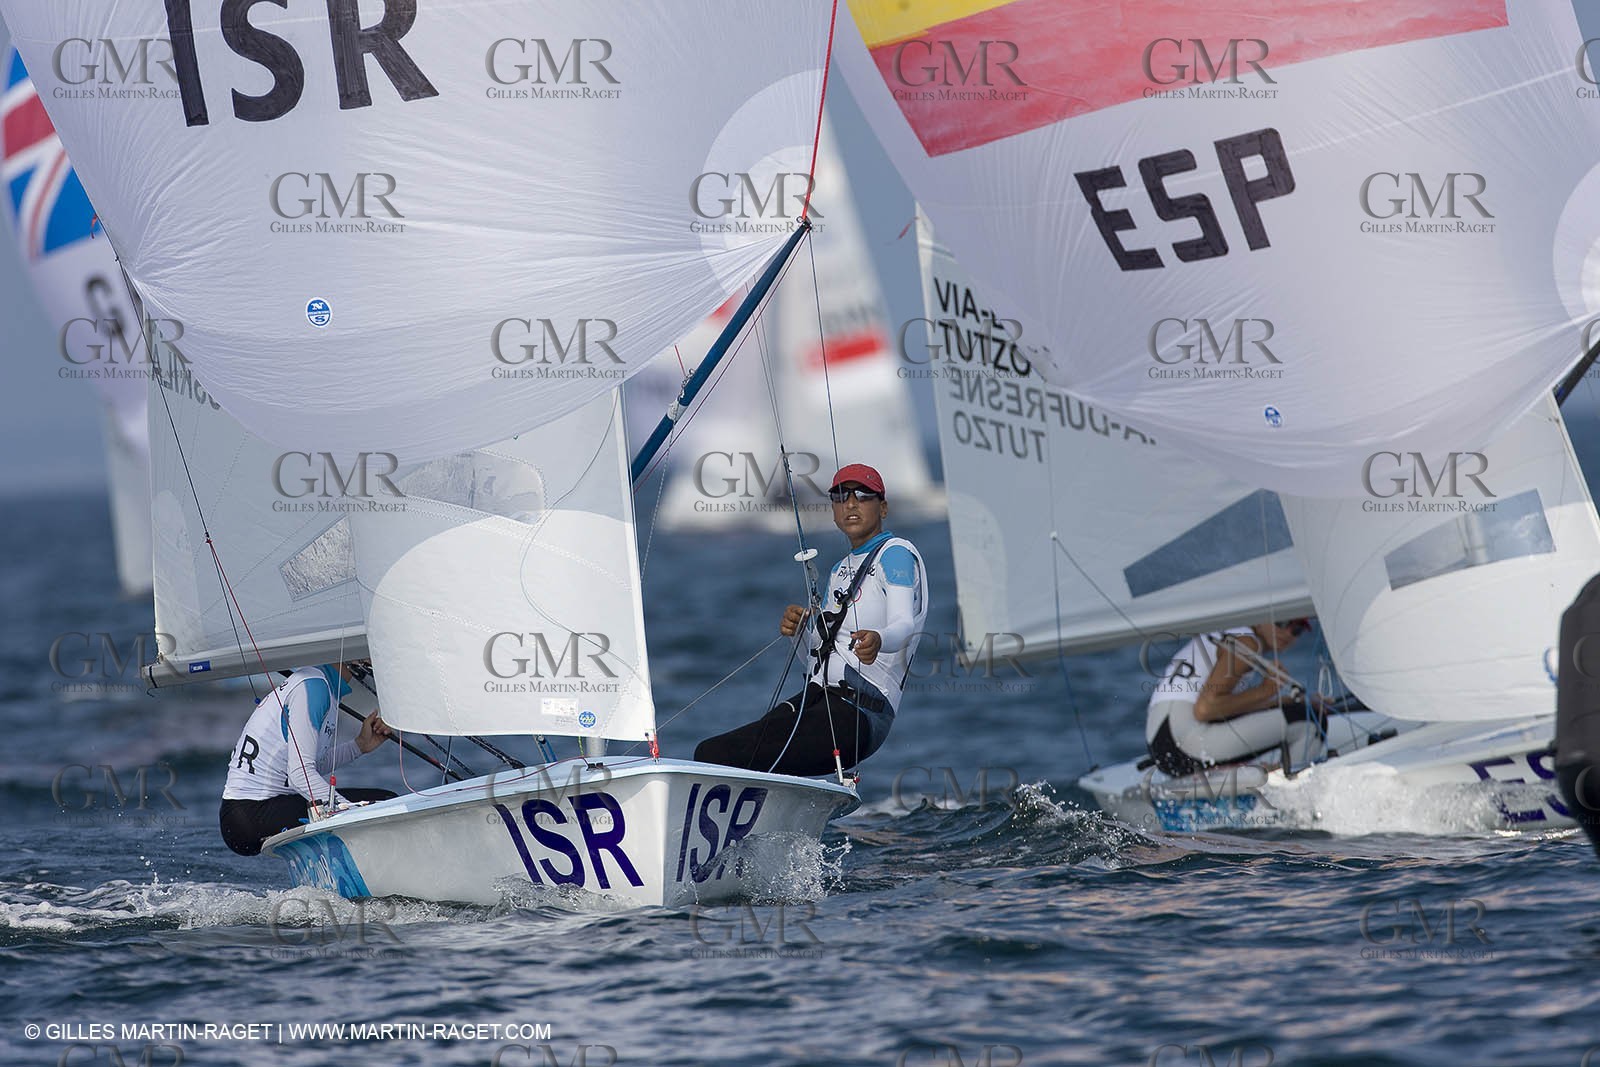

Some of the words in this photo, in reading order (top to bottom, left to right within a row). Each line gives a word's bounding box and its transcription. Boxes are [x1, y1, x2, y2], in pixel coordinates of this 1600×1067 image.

[163, 0, 439, 127] ISR
[1074, 128, 1296, 271] ESP
[938, 321, 1031, 376] TUTZO
[492, 792, 645, 890] ISR
[676, 783, 769, 883] ISR
